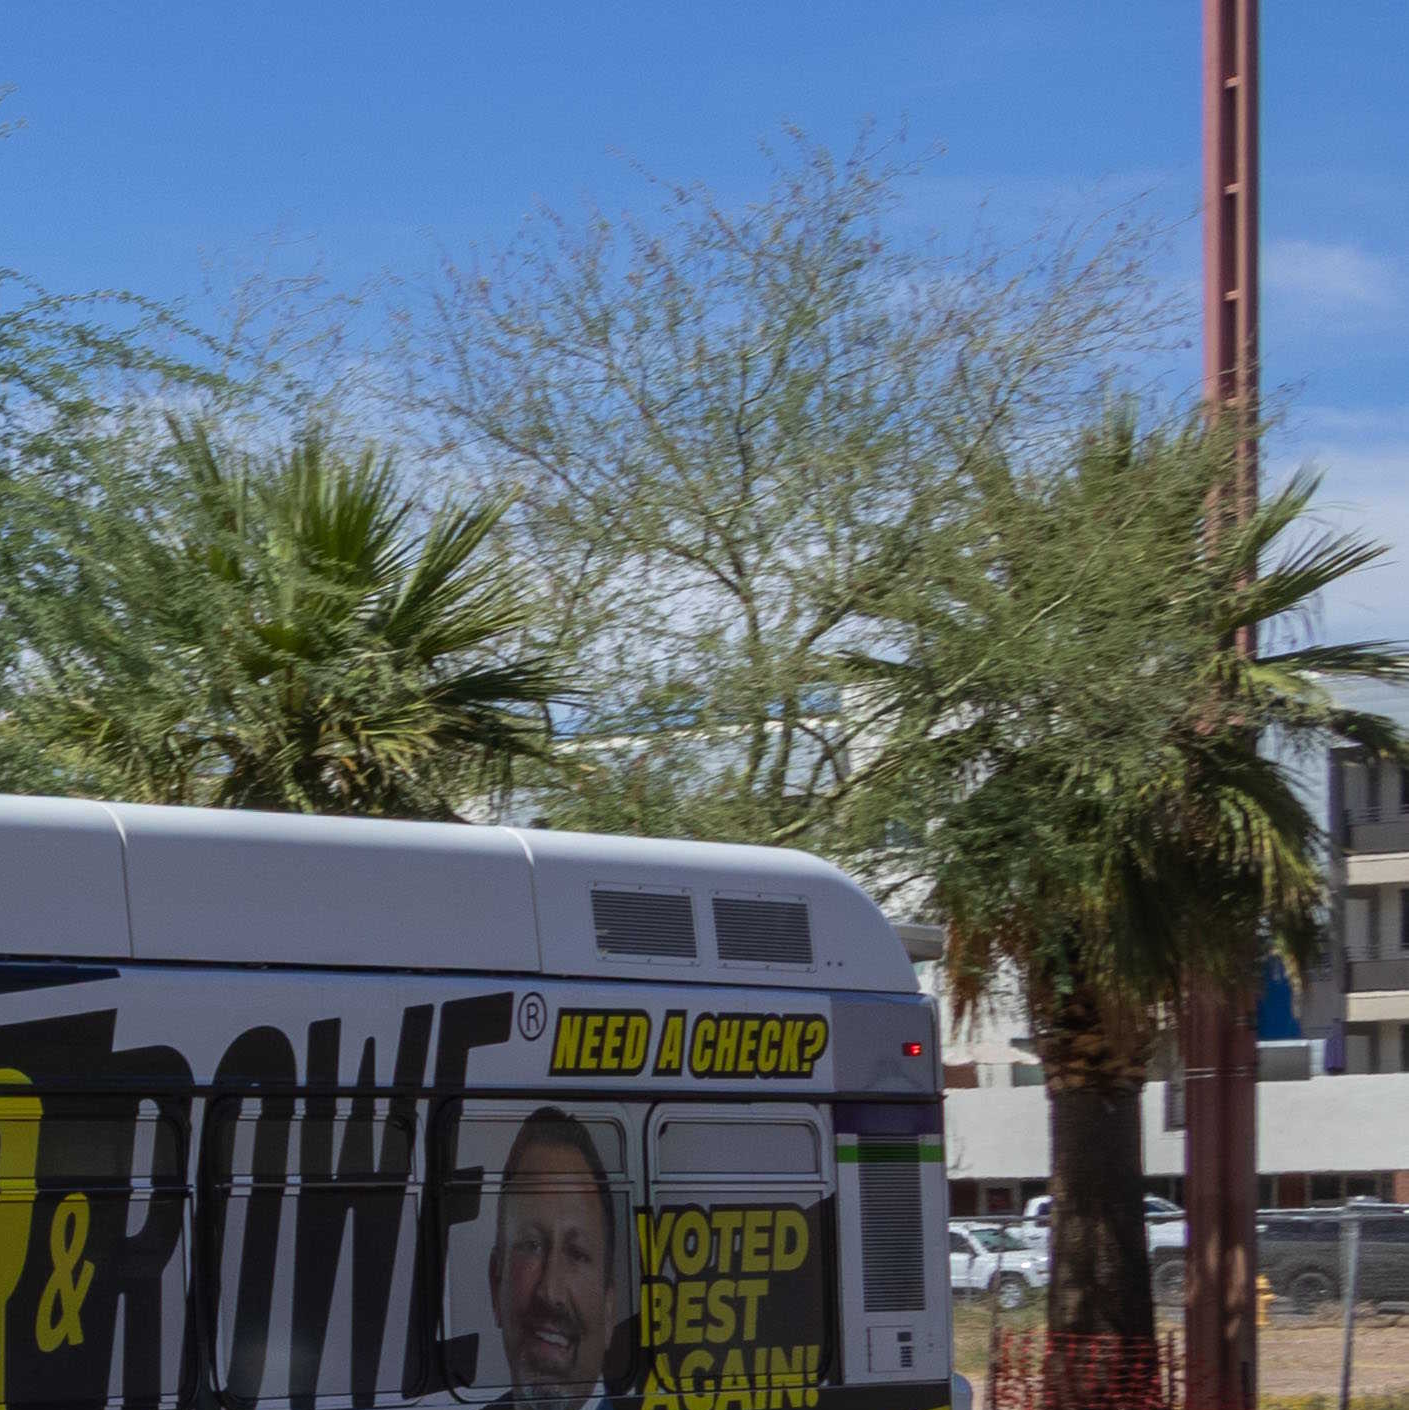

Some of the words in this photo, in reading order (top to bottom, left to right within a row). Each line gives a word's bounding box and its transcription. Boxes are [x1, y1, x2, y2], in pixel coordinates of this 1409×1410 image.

[552, 1014, 652, 1070] NEED
[658, 1016, 684, 1070] A
[691, 1017, 828, 1073] CHECK?
[35, 1191, 95, 1353] &
[635, 1208, 810, 1277] VOTED
[639, 1278, 770, 1348] BEST
